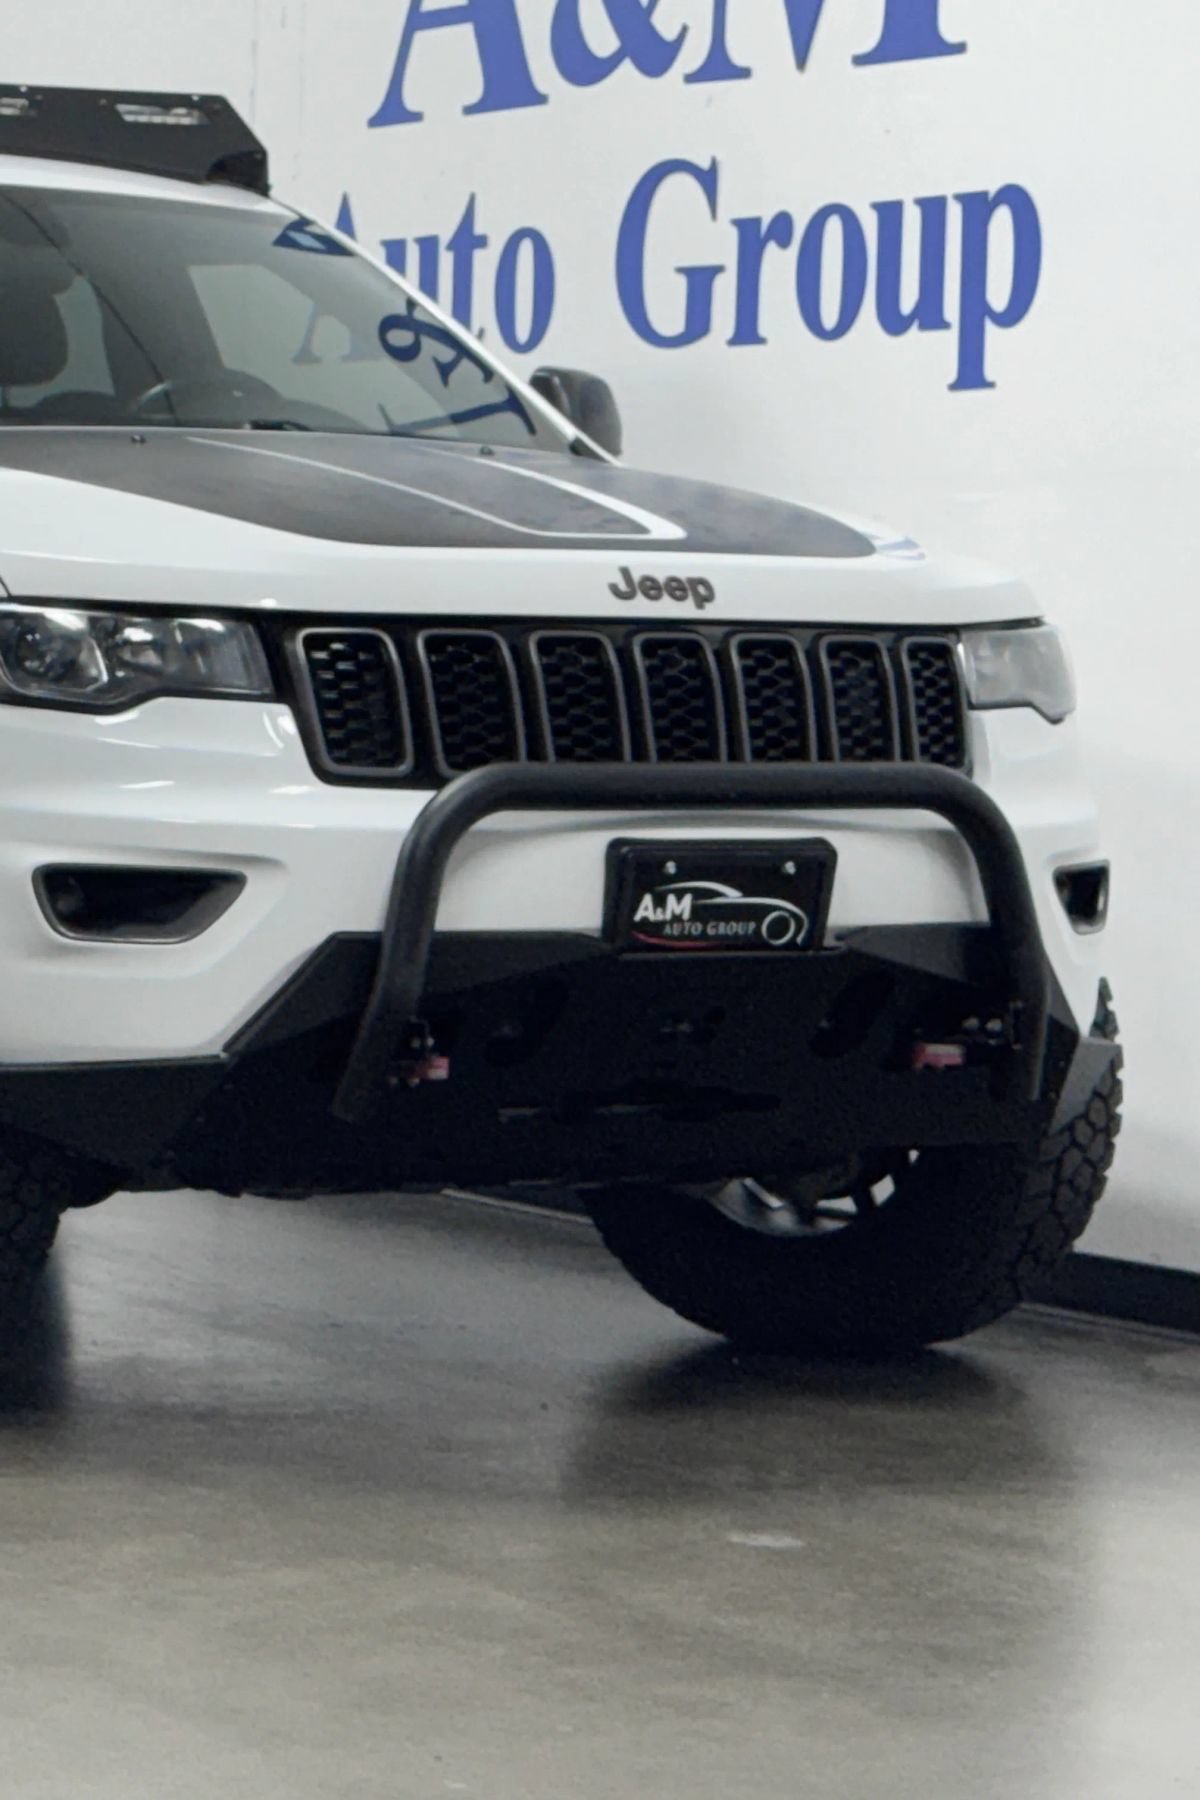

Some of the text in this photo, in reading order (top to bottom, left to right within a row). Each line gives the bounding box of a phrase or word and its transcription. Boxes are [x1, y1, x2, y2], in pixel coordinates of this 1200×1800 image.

[616, 157, 1042, 391] Group
[608, 566, 715, 610] Jeep
[633, 893, 693, 923] A&M
[663, 921, 756, 936] AUTO GROUP
